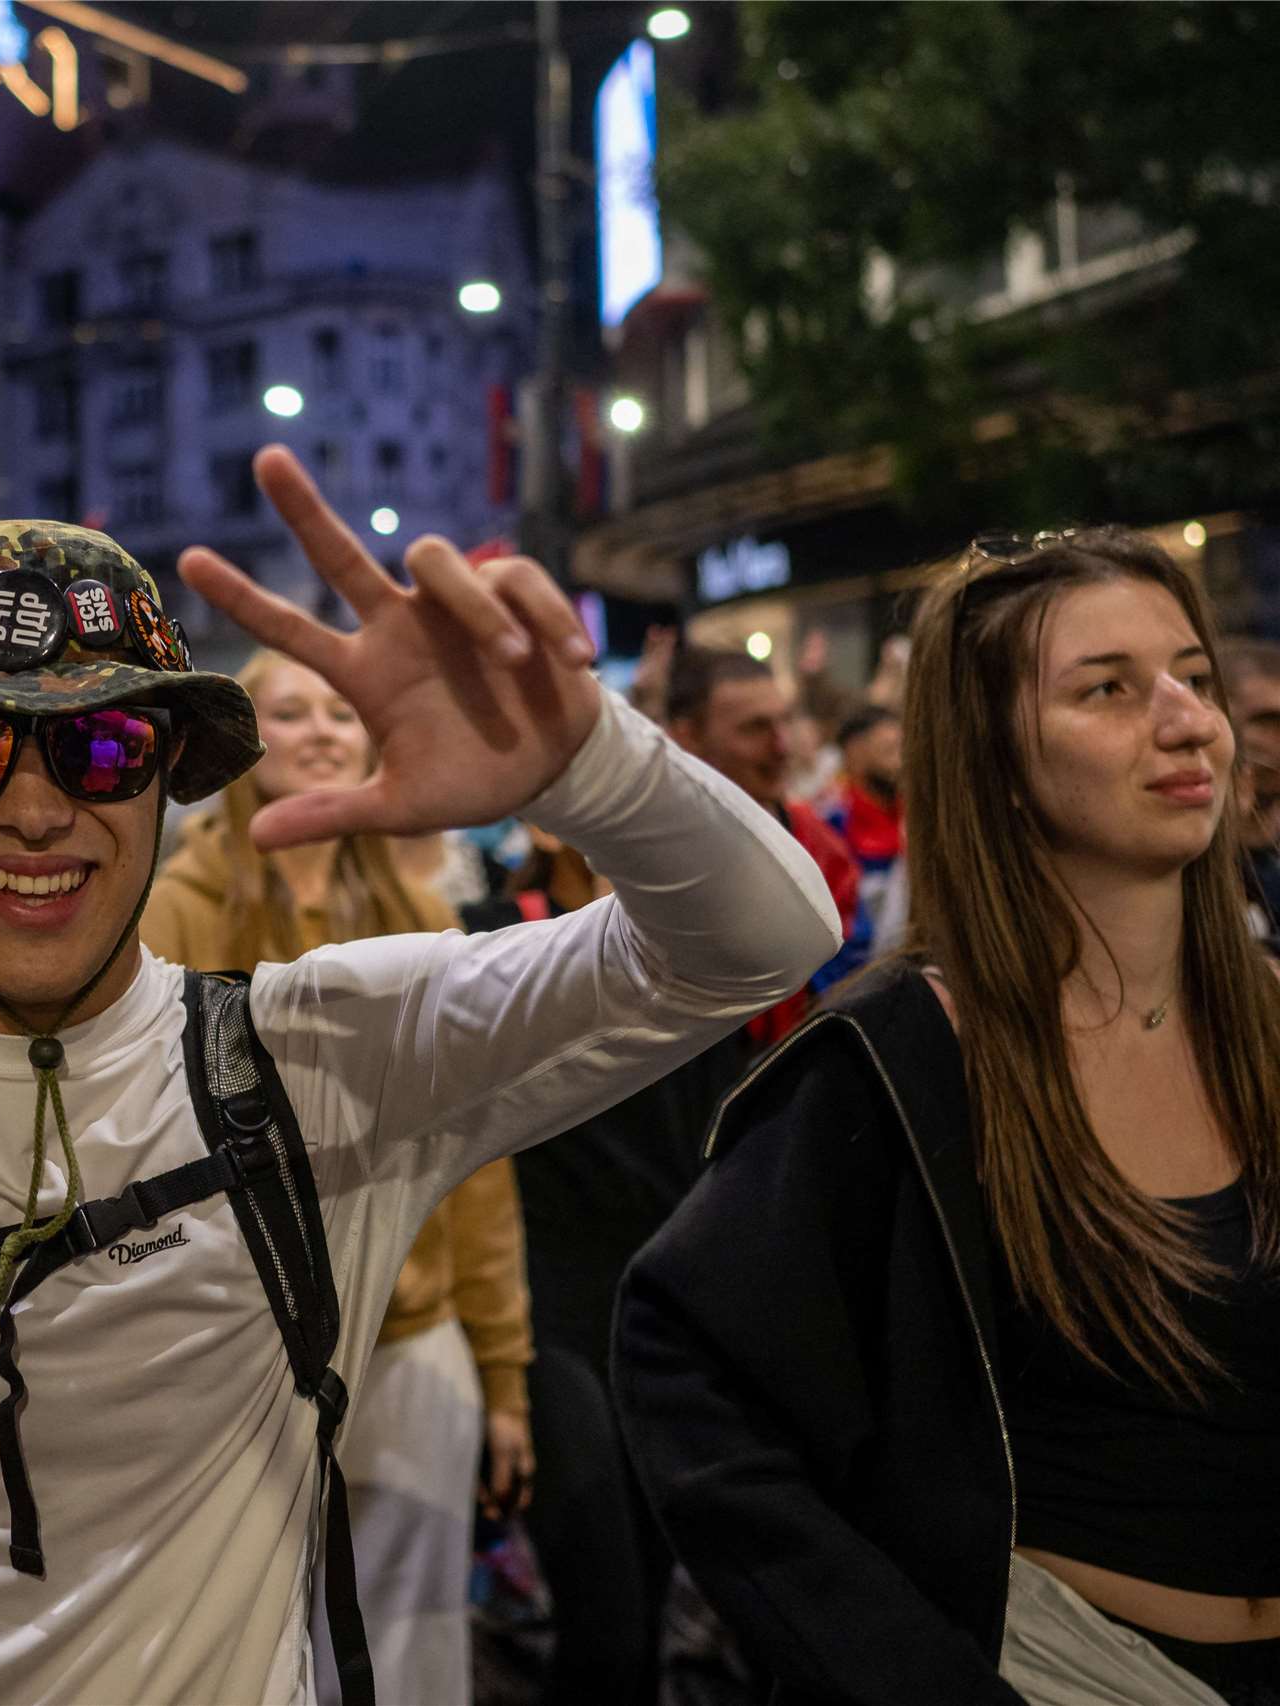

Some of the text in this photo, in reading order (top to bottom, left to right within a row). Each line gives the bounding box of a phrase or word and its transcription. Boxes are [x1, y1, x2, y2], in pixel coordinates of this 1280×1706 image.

[11, 592, 52, 647] ПДР
[73, 590, 100, 633] FCK
[90, 587, 114, 632] SNS
